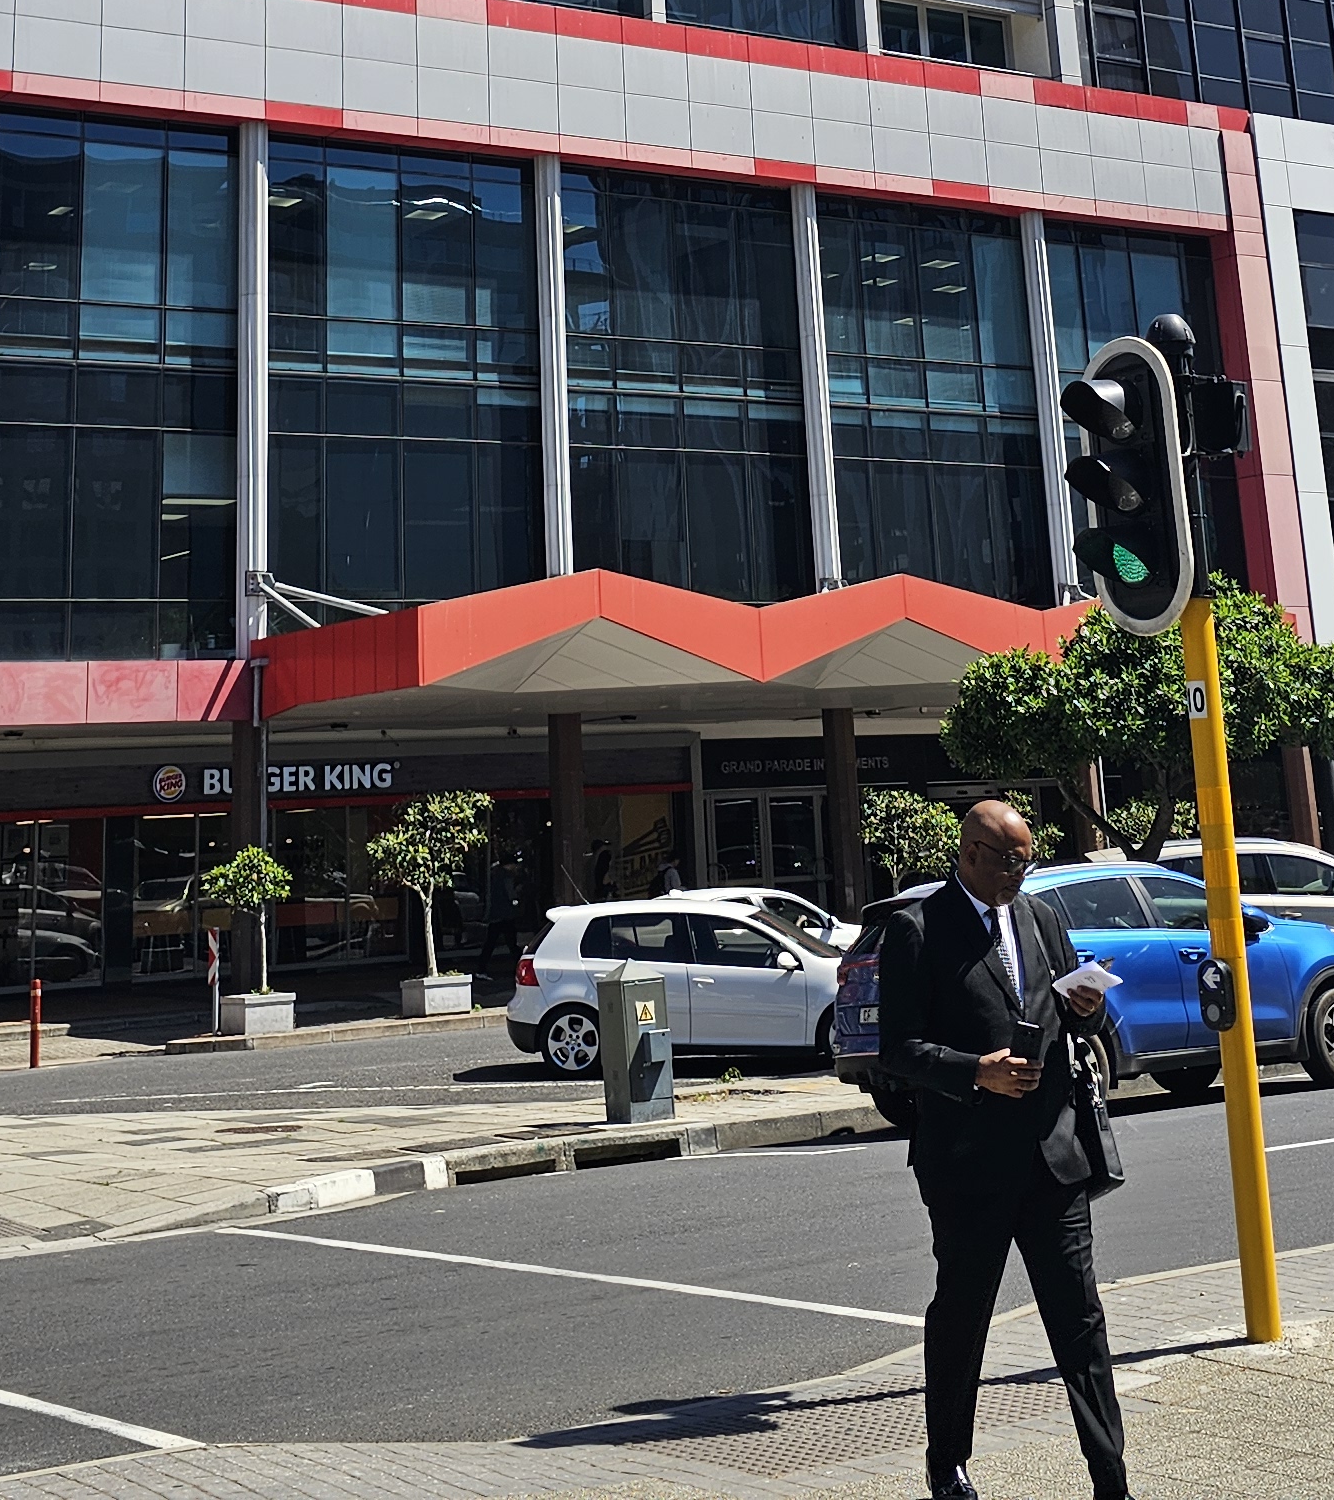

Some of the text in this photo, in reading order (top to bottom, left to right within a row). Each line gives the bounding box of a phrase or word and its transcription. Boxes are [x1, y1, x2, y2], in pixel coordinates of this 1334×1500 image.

[720, 760, 763, 775] GRAND
[766, 758, 812, 773] PARADE
[324, 763, 392, 791] KING
[158, 779, 183, 793] KING
